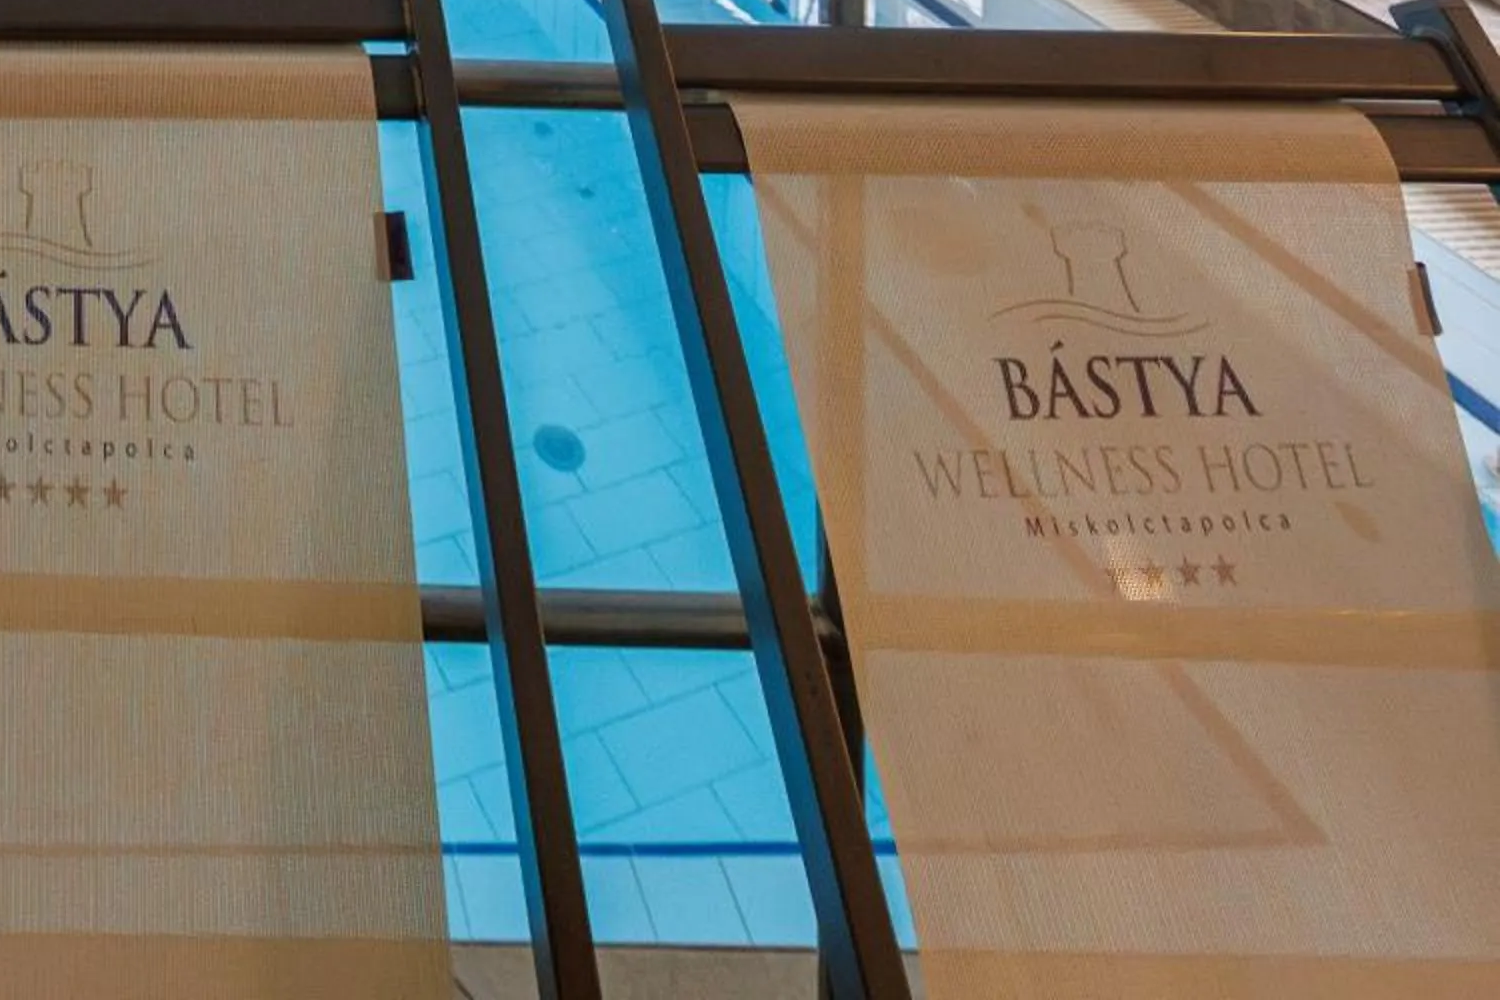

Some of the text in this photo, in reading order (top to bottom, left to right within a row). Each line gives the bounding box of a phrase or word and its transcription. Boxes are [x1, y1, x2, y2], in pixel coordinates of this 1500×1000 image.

[117, 375, 295, 428] HOTEL
[992, 340, 1264, 422] BÁSTYA
[912, 441, 1376, 500] WELLNESS HOTEL
[1025, 511, 1293, 540] Miskolctapolca
